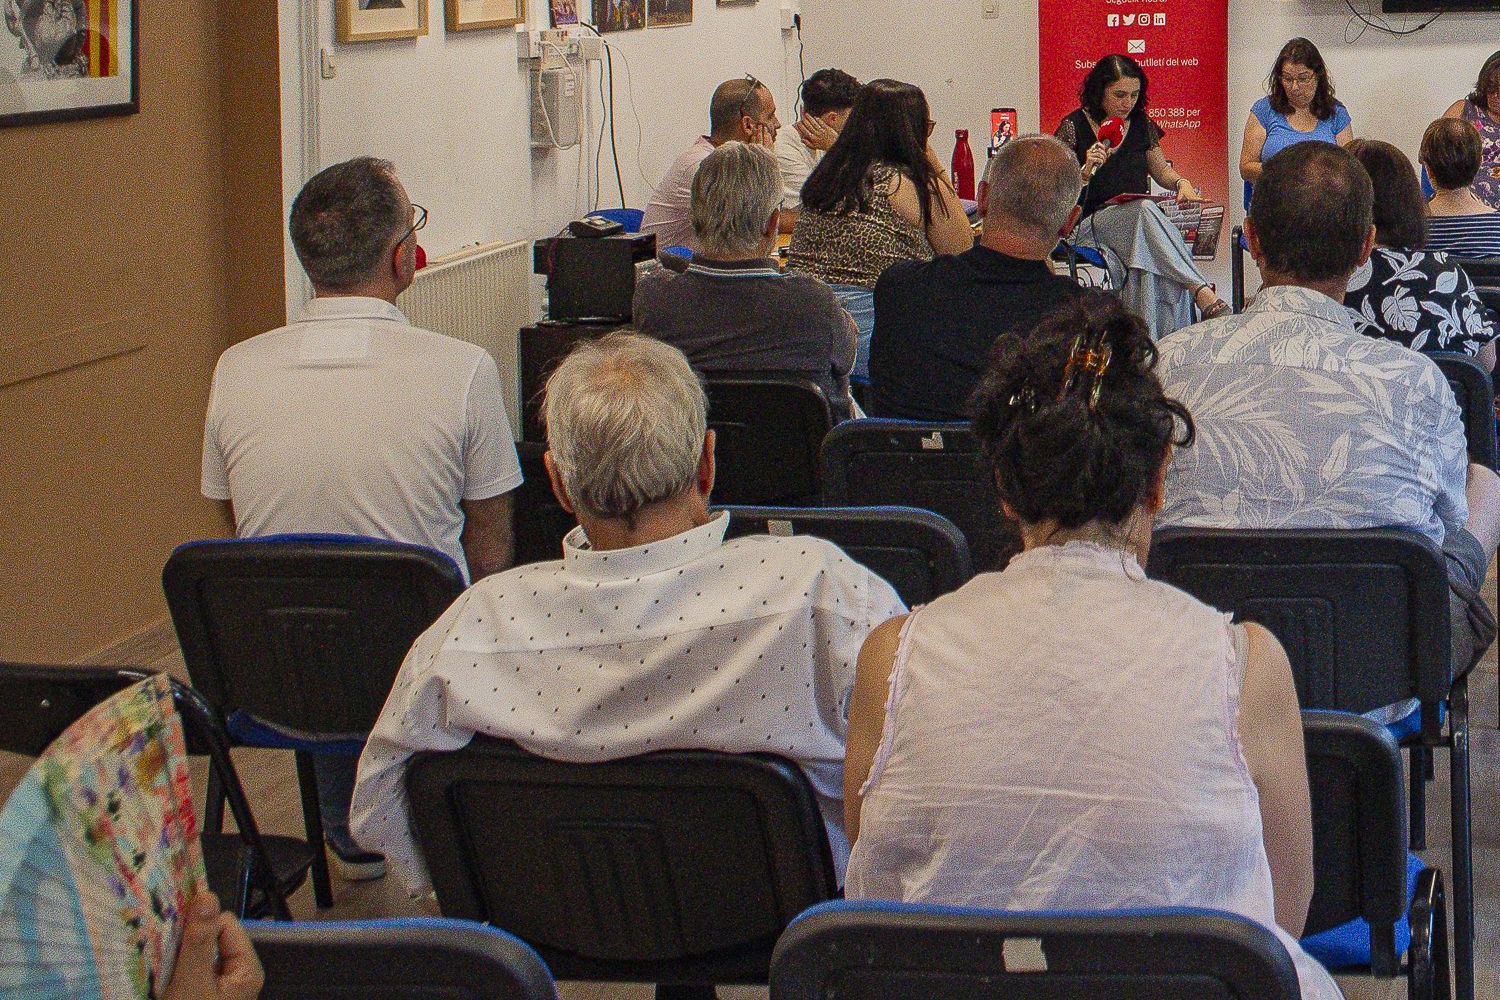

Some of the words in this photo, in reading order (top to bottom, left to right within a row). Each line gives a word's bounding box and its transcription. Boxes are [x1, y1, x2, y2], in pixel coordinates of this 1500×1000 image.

[1166, 57, 1179, 67] del
[1180, 57, 1199, 66] web
[1167, 108, 1185, 117] 388
[1186, 110, 1201, 118] per
